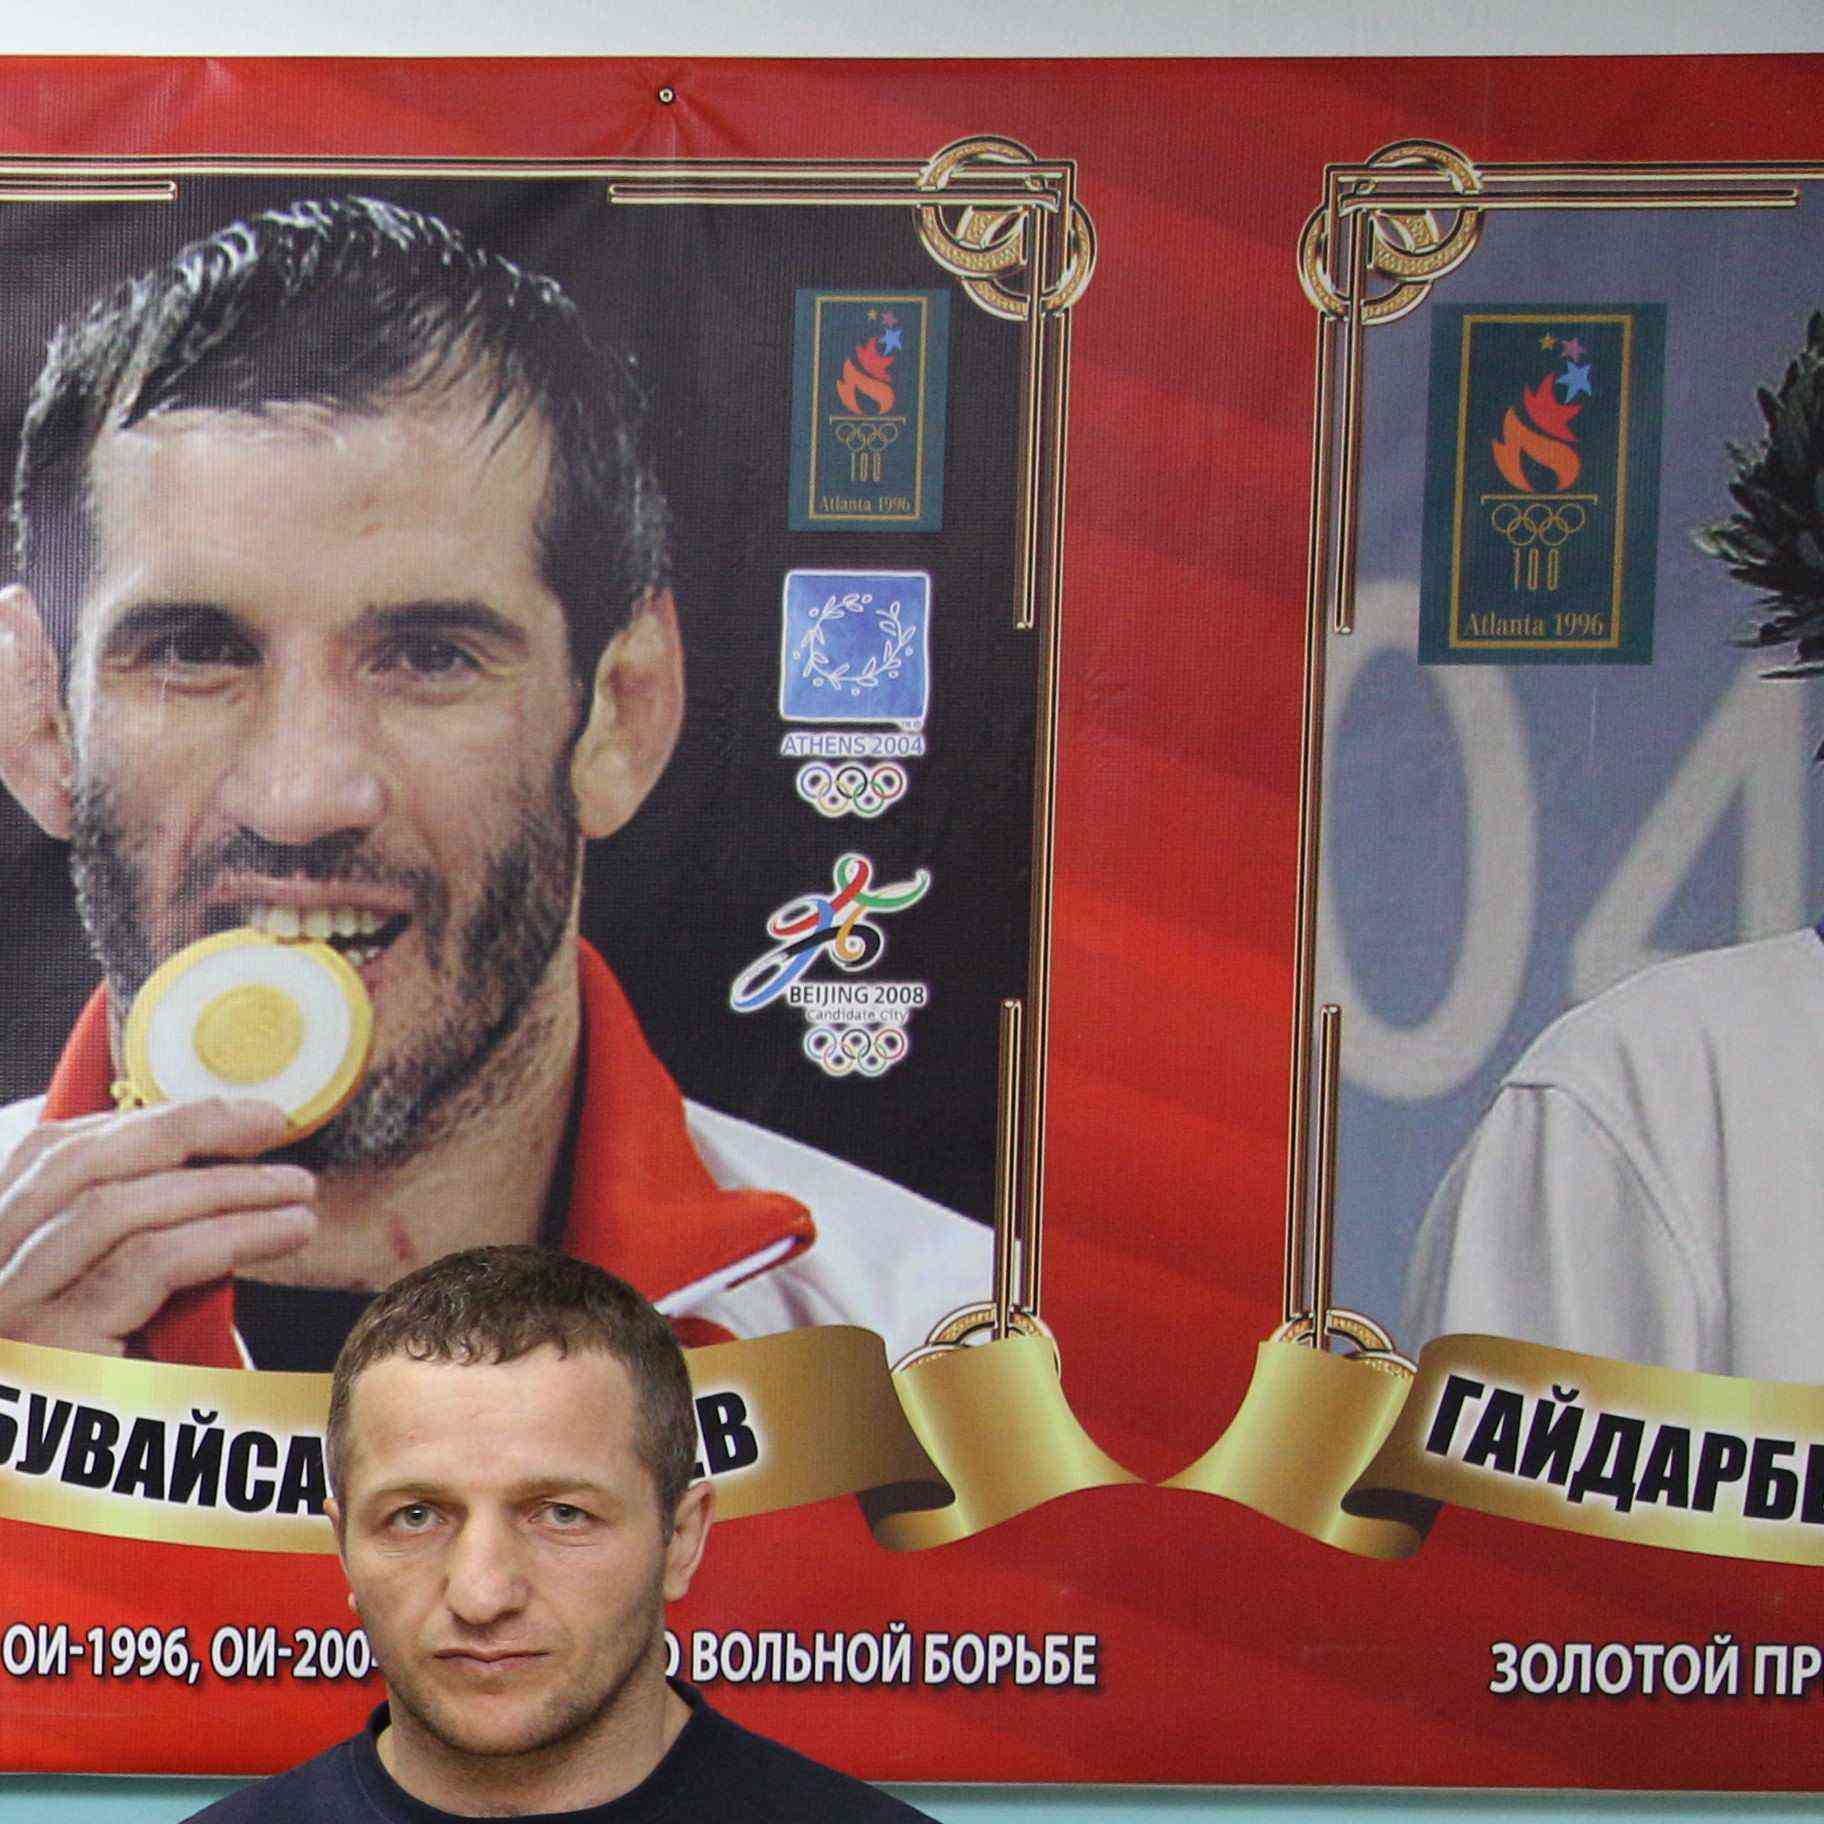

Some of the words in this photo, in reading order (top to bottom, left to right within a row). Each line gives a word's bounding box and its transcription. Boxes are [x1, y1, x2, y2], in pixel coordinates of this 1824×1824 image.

[818, 495, 872, 513] Atlanta
[878, 496, 911, 512] 1996
[1464, 611, 1545, 637] Atlanta
[1555, 612, 1605, 637] 1996
[782, 735, 866, 755] ATHENS
[871, 736, 923, 755] 2004
[789, 985, 870, 1005] BEIJING
[874, 986, 926, 1005] 2008
[1, 1625, 201, 1685] ОИ-1996,
[210, 1625, 378, 1681] ОИ-200
[692, 1623, 911, 1684] ВОЛЬНОЙ
[923, 1632, 1098, 1687] БОРЬБЕ
[1489, 1634, 1739, 1696] ЗОЛОТОЙ
[1753, 1644, 1824, 1696] ПР
